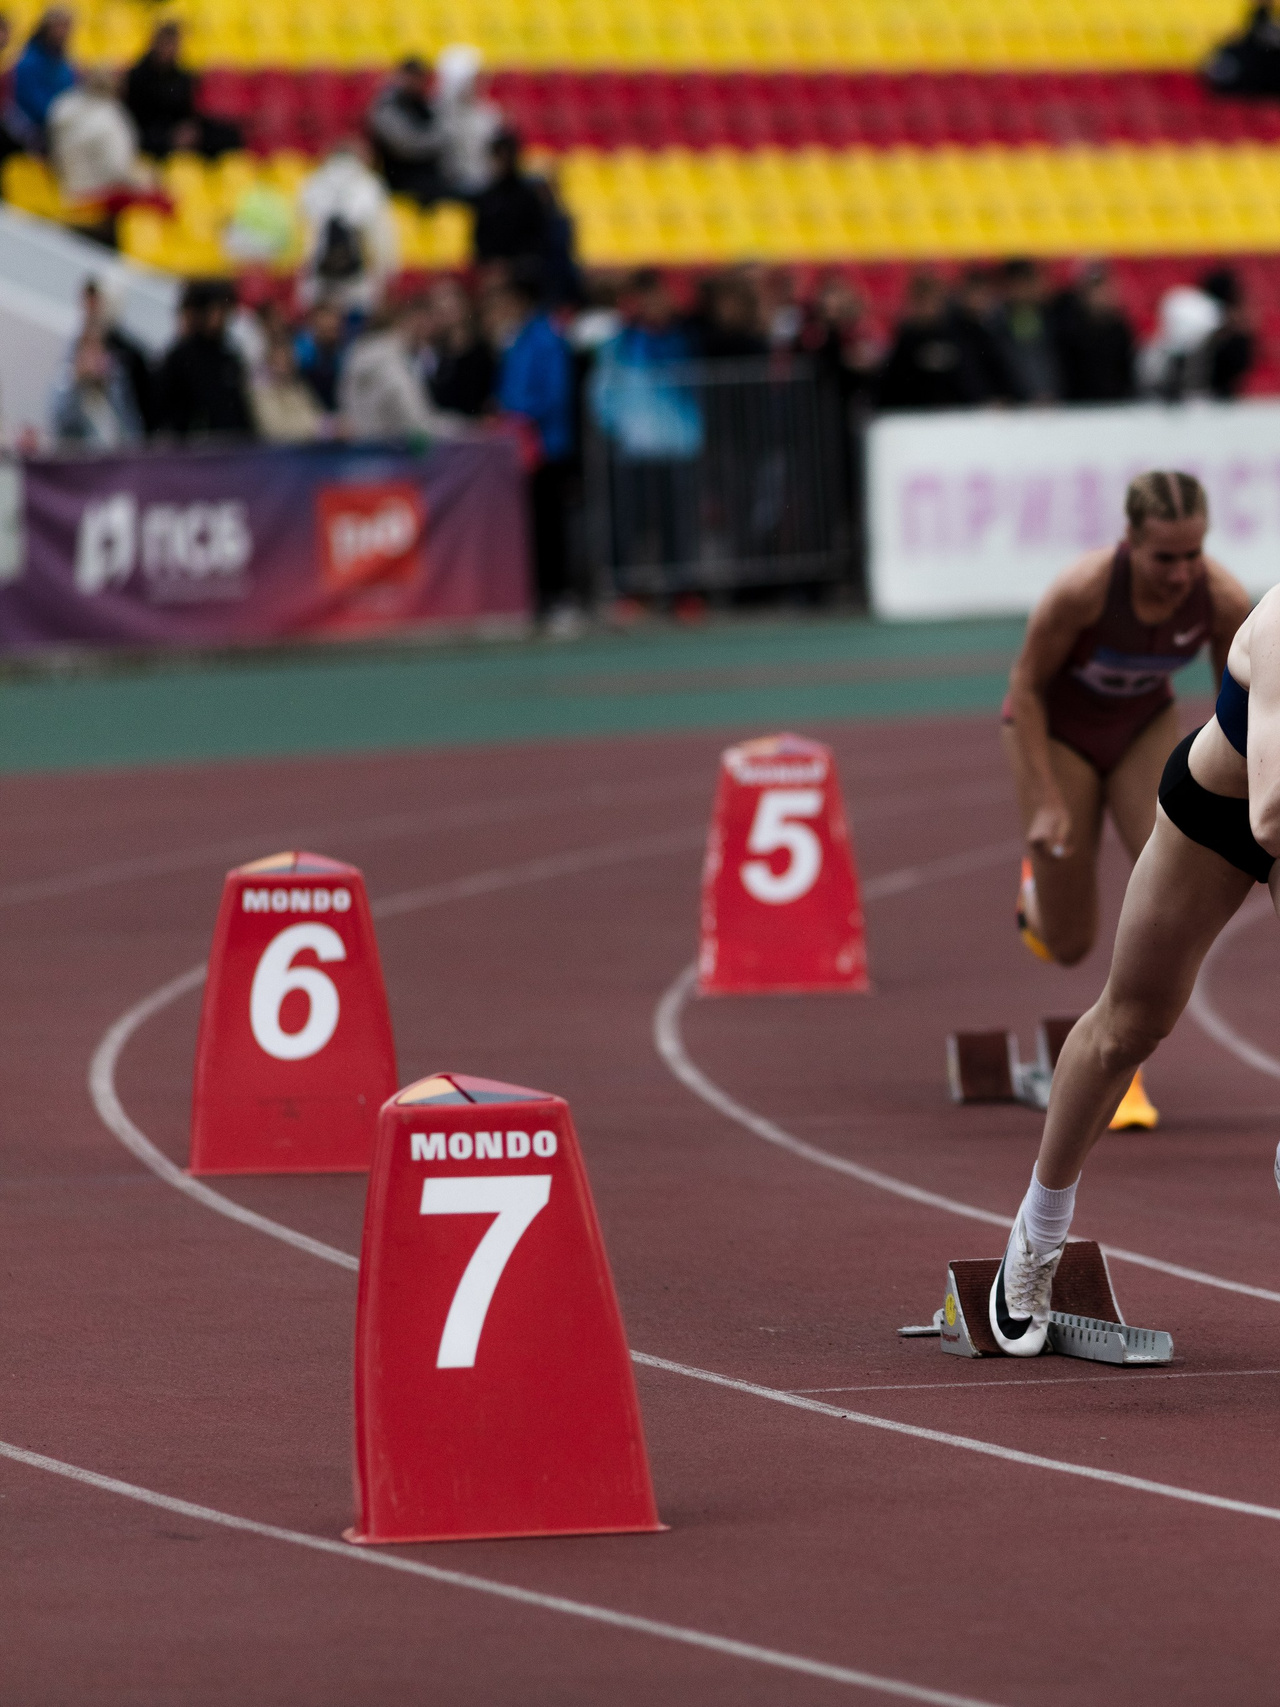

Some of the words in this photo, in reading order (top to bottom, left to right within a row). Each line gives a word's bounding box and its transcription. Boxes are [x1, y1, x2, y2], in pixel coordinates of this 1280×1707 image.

[242, 888, 351, 913] MONDO
[739, 788, 824, 906] 5
[250, 921, 347, 1061] 6
[410, 1130, 558, 1161] MONDO
[419, 1174, 552, 1369] 7
